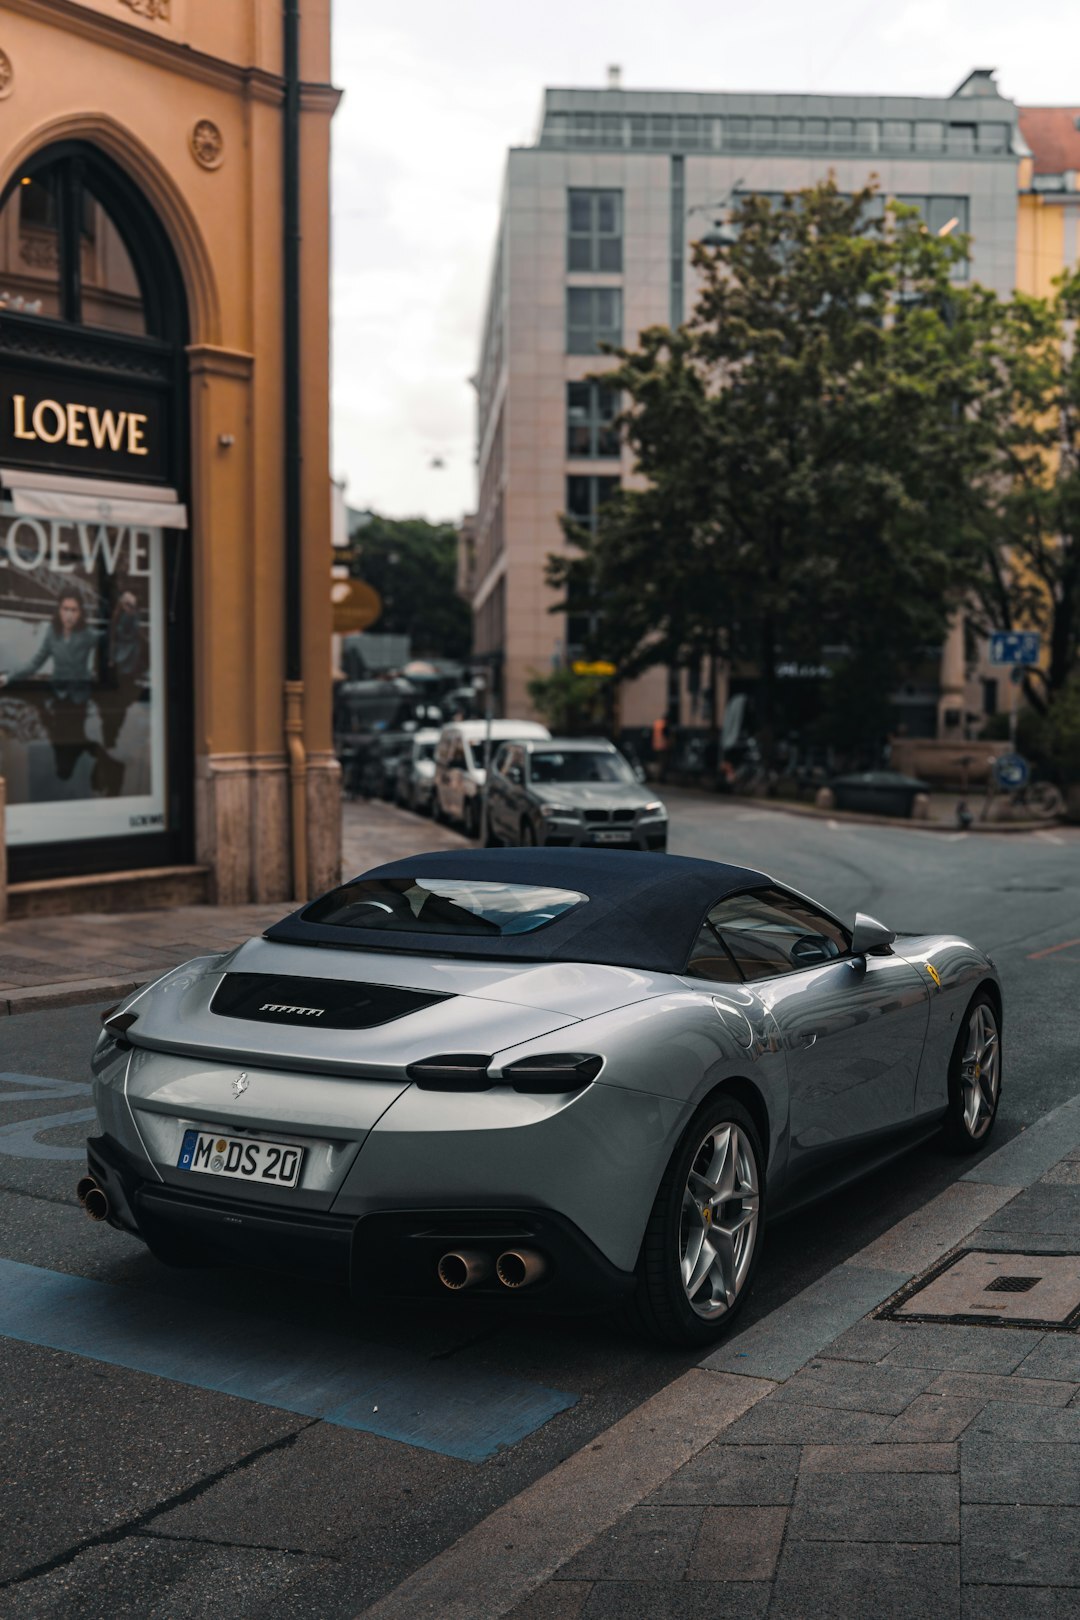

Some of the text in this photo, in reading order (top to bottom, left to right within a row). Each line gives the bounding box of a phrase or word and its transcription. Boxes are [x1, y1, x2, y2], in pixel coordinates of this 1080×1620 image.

[13, 394, 148, 455] LOEWE
[0, 517, 151, 577] OEWE
[259, 1003, 325, 1017] Ferrari
[182, 1154, 190, 1164] D
